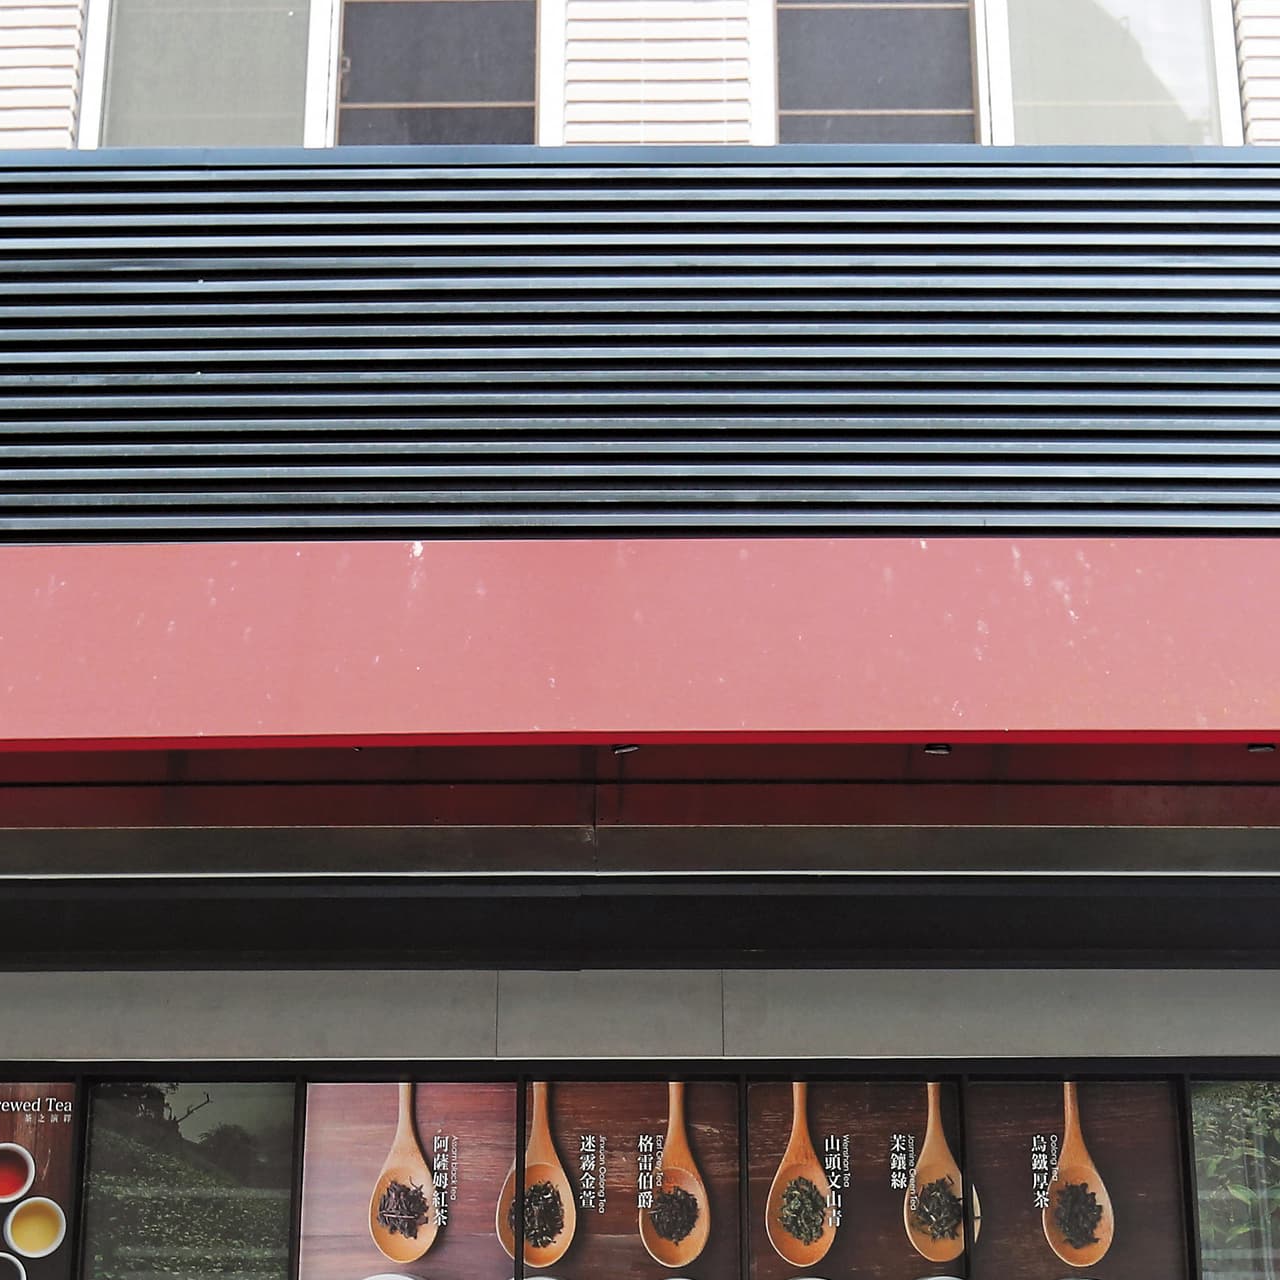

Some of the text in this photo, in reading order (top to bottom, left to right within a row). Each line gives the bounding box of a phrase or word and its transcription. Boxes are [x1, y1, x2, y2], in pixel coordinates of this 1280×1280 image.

[46, 1097, 73, 1112] Tea
[432, 1135, 449, 1226] 阿薩姆紅茶
[579, 1135, 596, 1208] 迷霧金萱
[637, 1135, 654, 1208] 格雷伯爵
[824, 1134, 842, 1227] 山頭文山青
